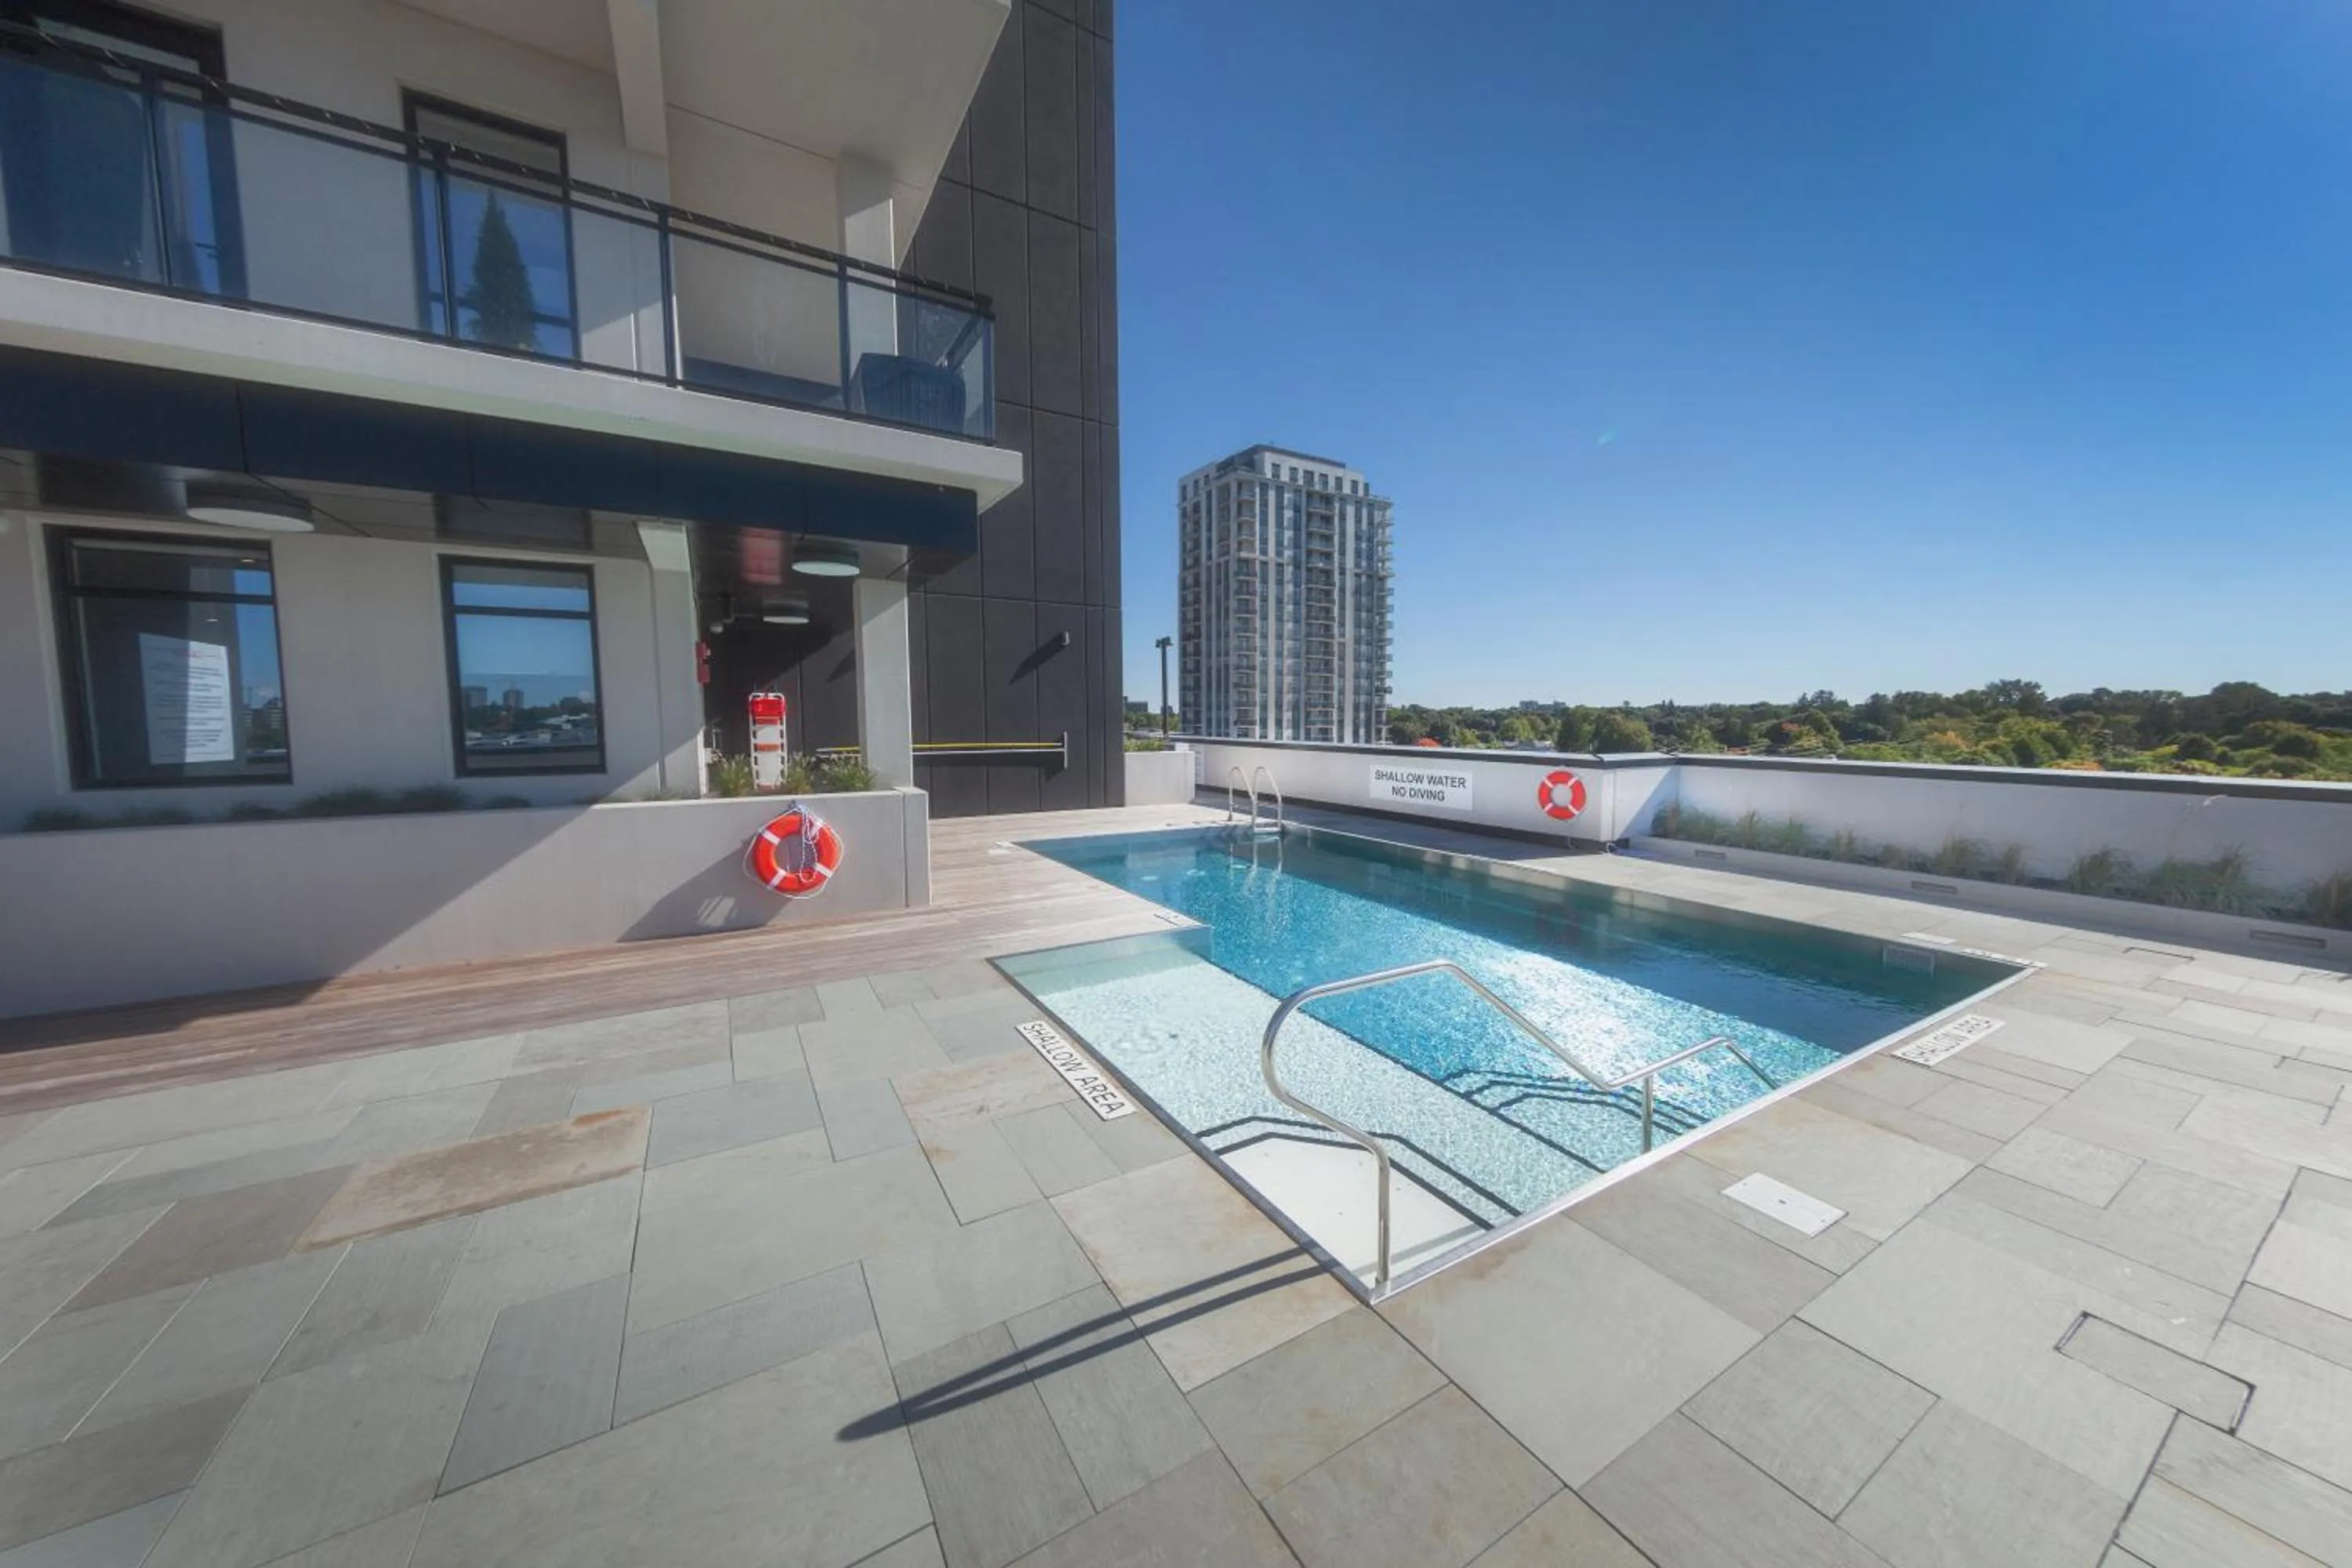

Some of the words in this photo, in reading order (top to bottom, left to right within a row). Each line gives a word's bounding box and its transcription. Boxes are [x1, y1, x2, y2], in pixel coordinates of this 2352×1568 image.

[1374, 769, 1425, 785] SHALLOW
[1426, 774, 1467, 789] WATER
[1392, 786, 1407, 797] NO
[1409, 788, 1445, 801] DIVING
[1023, 1023, 1088, 1072] SHALLOW
[1074, 1076, 1125, 1114] AREA
